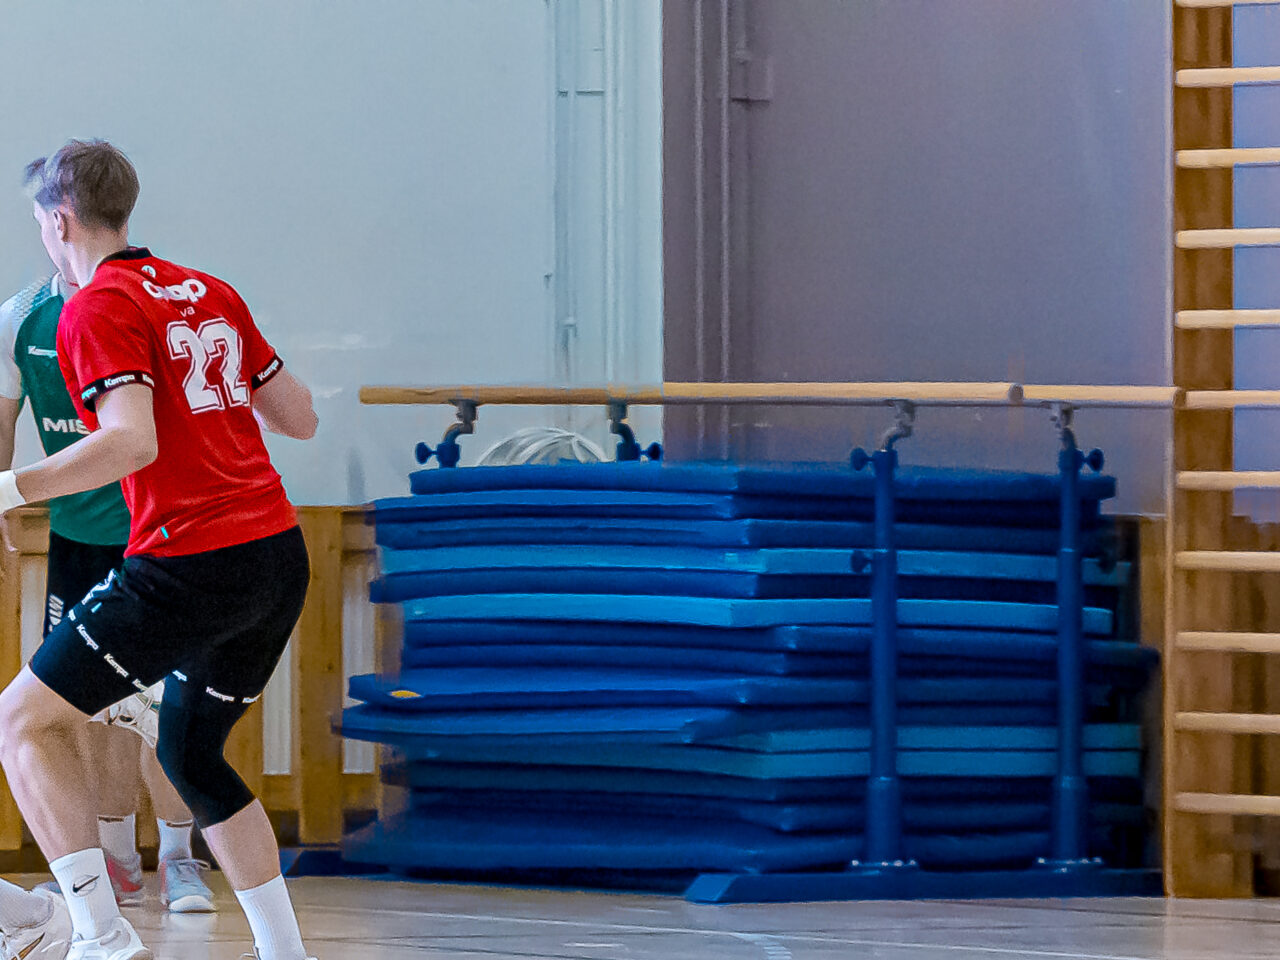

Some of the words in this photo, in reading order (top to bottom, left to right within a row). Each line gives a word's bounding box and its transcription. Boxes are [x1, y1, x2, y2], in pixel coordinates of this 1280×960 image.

[180, 306, 195, 317] va
[166, 317, 251, 414] 22
[104, 374, 136, 388] Kempa
[76, 623, 99, 651] Kempa
[104, 653, 129, 678] Kempa
[205, 686, 235, 702] Kempa
